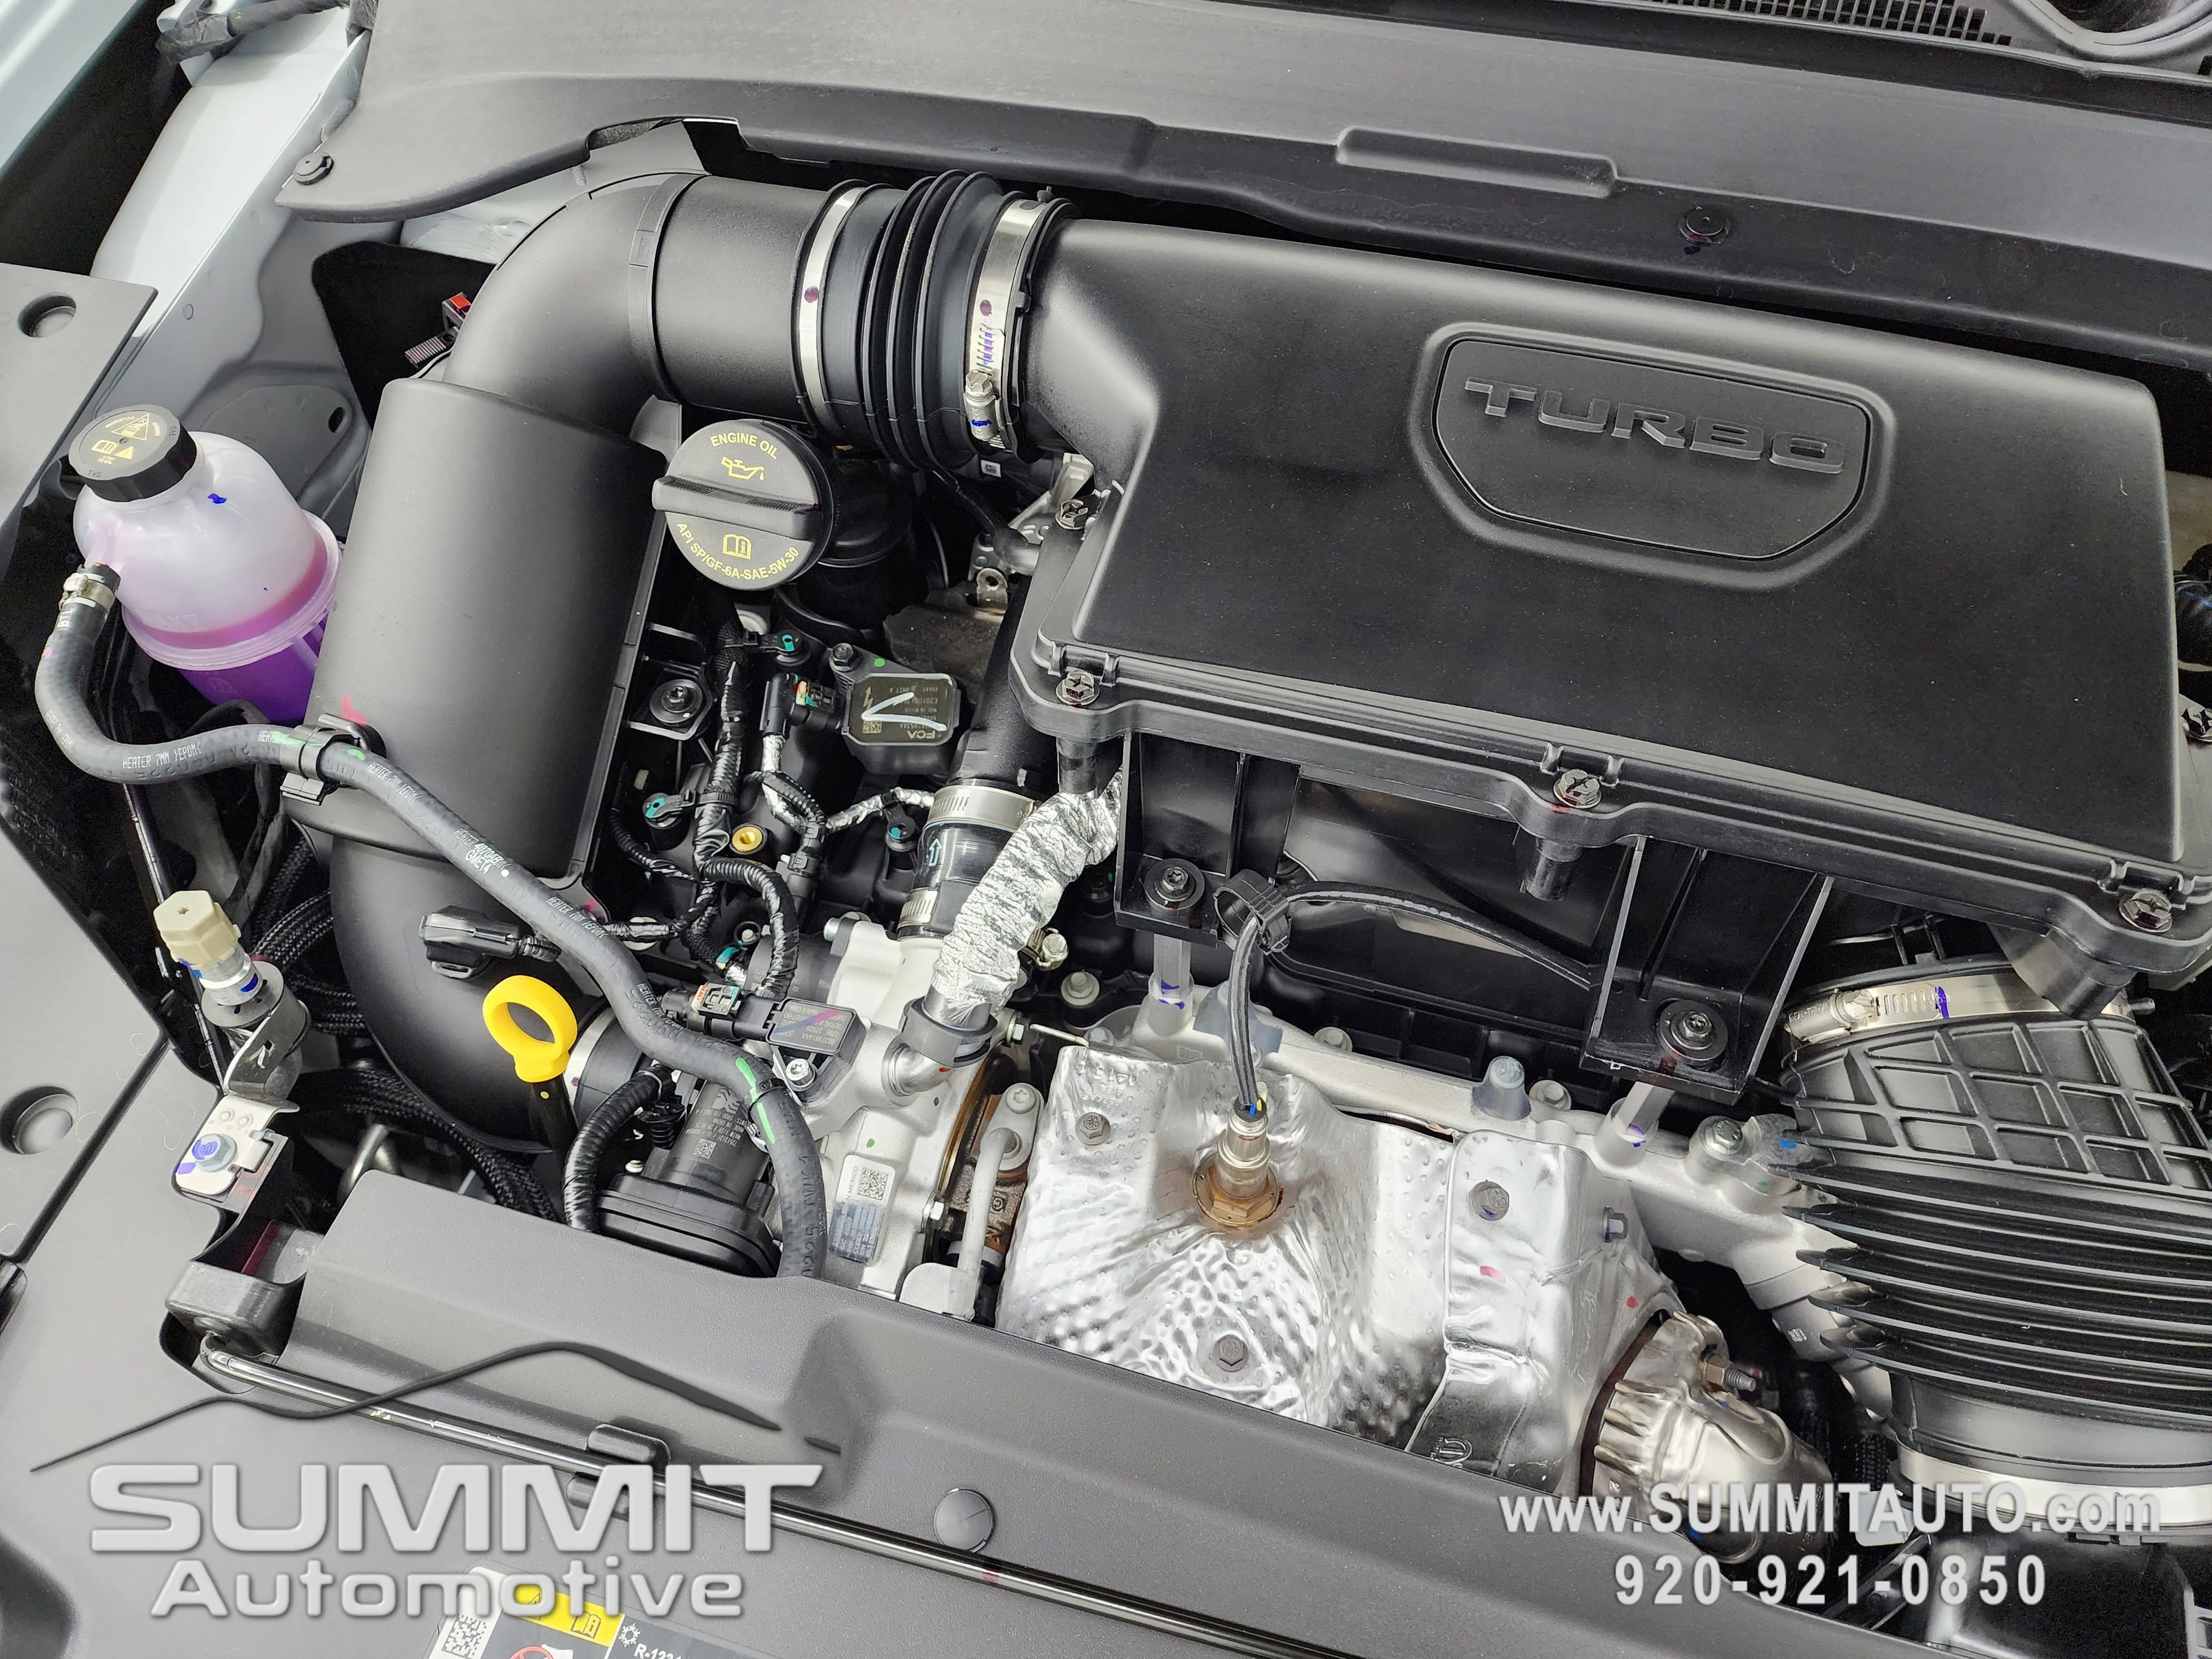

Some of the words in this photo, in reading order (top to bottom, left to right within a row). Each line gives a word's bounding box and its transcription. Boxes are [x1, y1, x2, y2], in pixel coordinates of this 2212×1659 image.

[169, 425, 178, 437] TVS
[1464, 377, 1845, 474] TURBO
[710, 432, 758, 447] ENGINE
[760, 440, 778, 460] OIL
[677, 523, 691, 544] API
[690, 542, 800, 580] SP/GF-6A-SAE-5W-30
[57, 607, 75, 629] BTL
[906, 730, 936, 739] FCA
[122, 754, 151, 769] HEATER
[155, 752, 170, 766] 7MM
[367, 761, 390, 781] HEATER
[453, 828, 479, 847] HEATER
[465, 849, 494, 874] GMET4
[546, 895, 573, 915] HEATER
[637, 983, 657, 1006] HEATER
[848, 1165, 858, 1194] MEXICO
